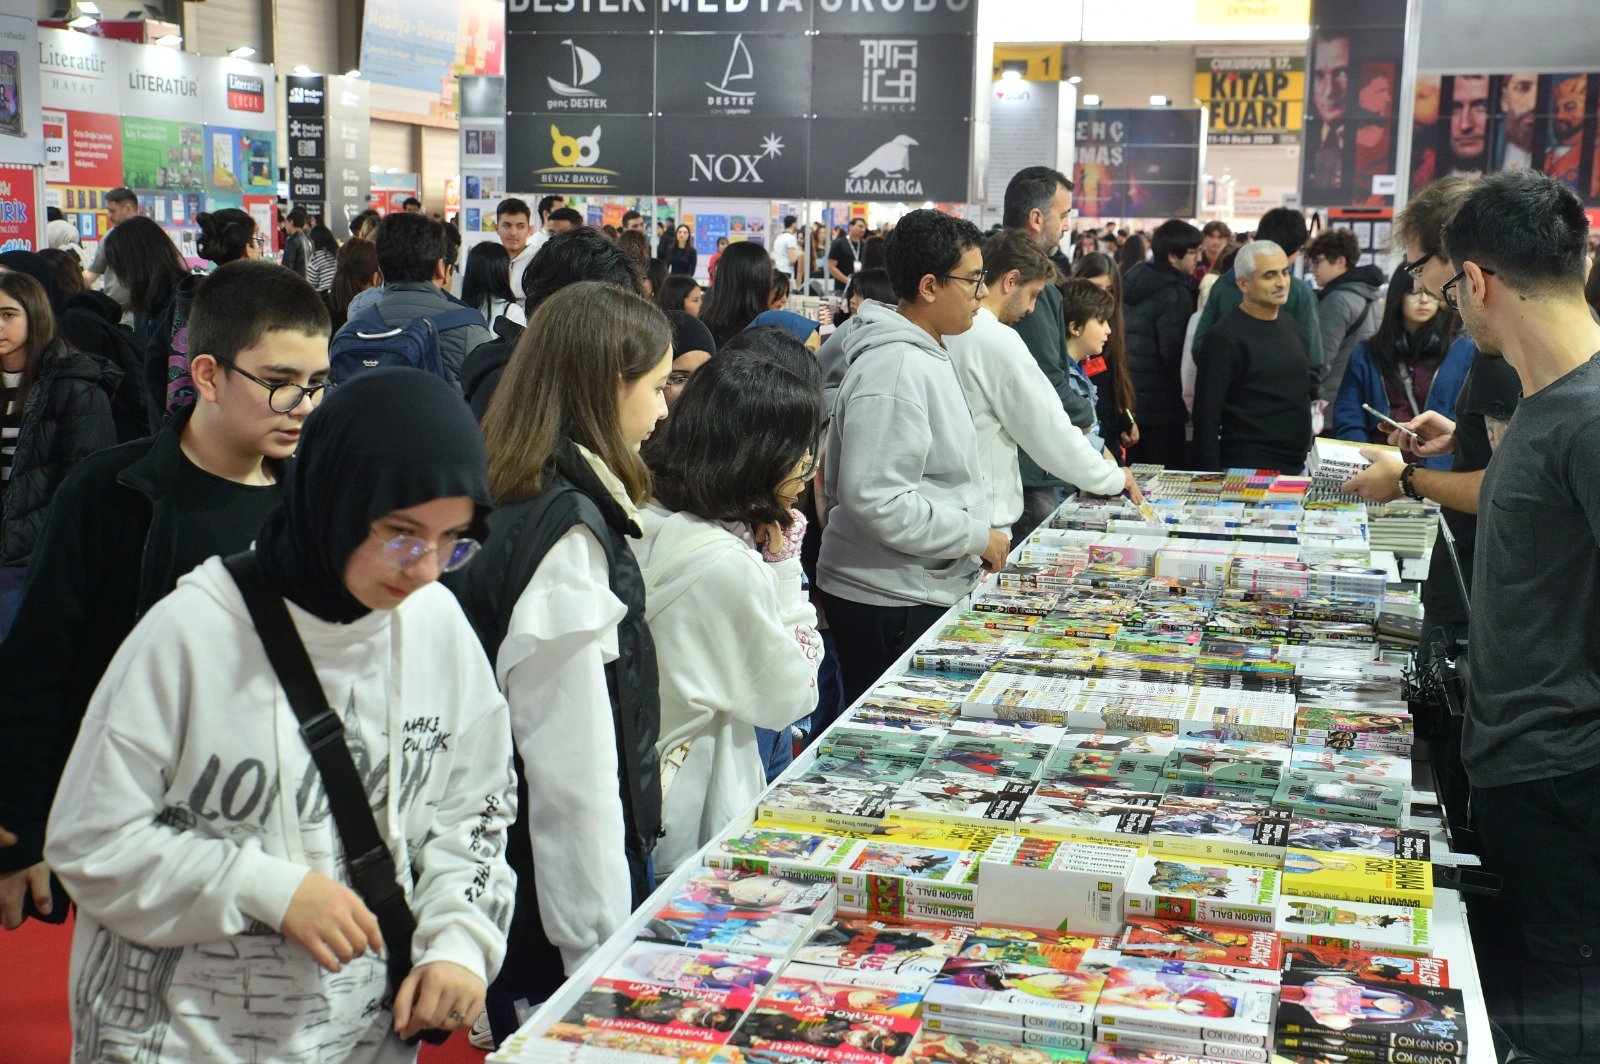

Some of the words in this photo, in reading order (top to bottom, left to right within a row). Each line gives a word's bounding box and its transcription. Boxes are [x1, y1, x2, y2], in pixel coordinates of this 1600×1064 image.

[38, 41, 107, 73] Literatür
[1041, 56, 1051, 76] 1
[52, 78, 95, 95] HAYAT
[128, 68, 198, 97] LİTERATÜR
[1211, 70, 1289, 98] KİTAP
[546, 99, 568, 110] genç
[570, 98, 608, 109] DESTEK
[707, 96, 754, 106] DESTEK
[862, 104, 916, 112] ATHICA
[1209, 101, 1288, 127] FUARI
[689, 154, 764, 183] NOX
[541, 173, 570, 184] BEYAZ
[572, 174, 609, 186] BAYKUŞ
[844, 178, 923, 196] KARAKARGA
[402, 716, 440, 732] MAKE
[1222, 847, 1239, 856] Dogs
[1239, 849, 1256, 858] Stray
[1256, 851, 1281, 860] Bungou
[1365, 857, 1393, 873] FISH
[780, 870, 801, 881] BALL
[1395, 860, 1425, 890] BANANA
[916, 887, 938, 897] BALL
[939, 890, 974, 902] DRAGON
[1368, 894, 1388, 906] FISH
[1387, 896, 1421, 908] BANANA
[917, 905, 939, 915] BALL
[940, 908, 975, 920] DRAGON
[1209, 909, 1233, 919] BALL
[1235, 911, 1272, 924] DRAGON
